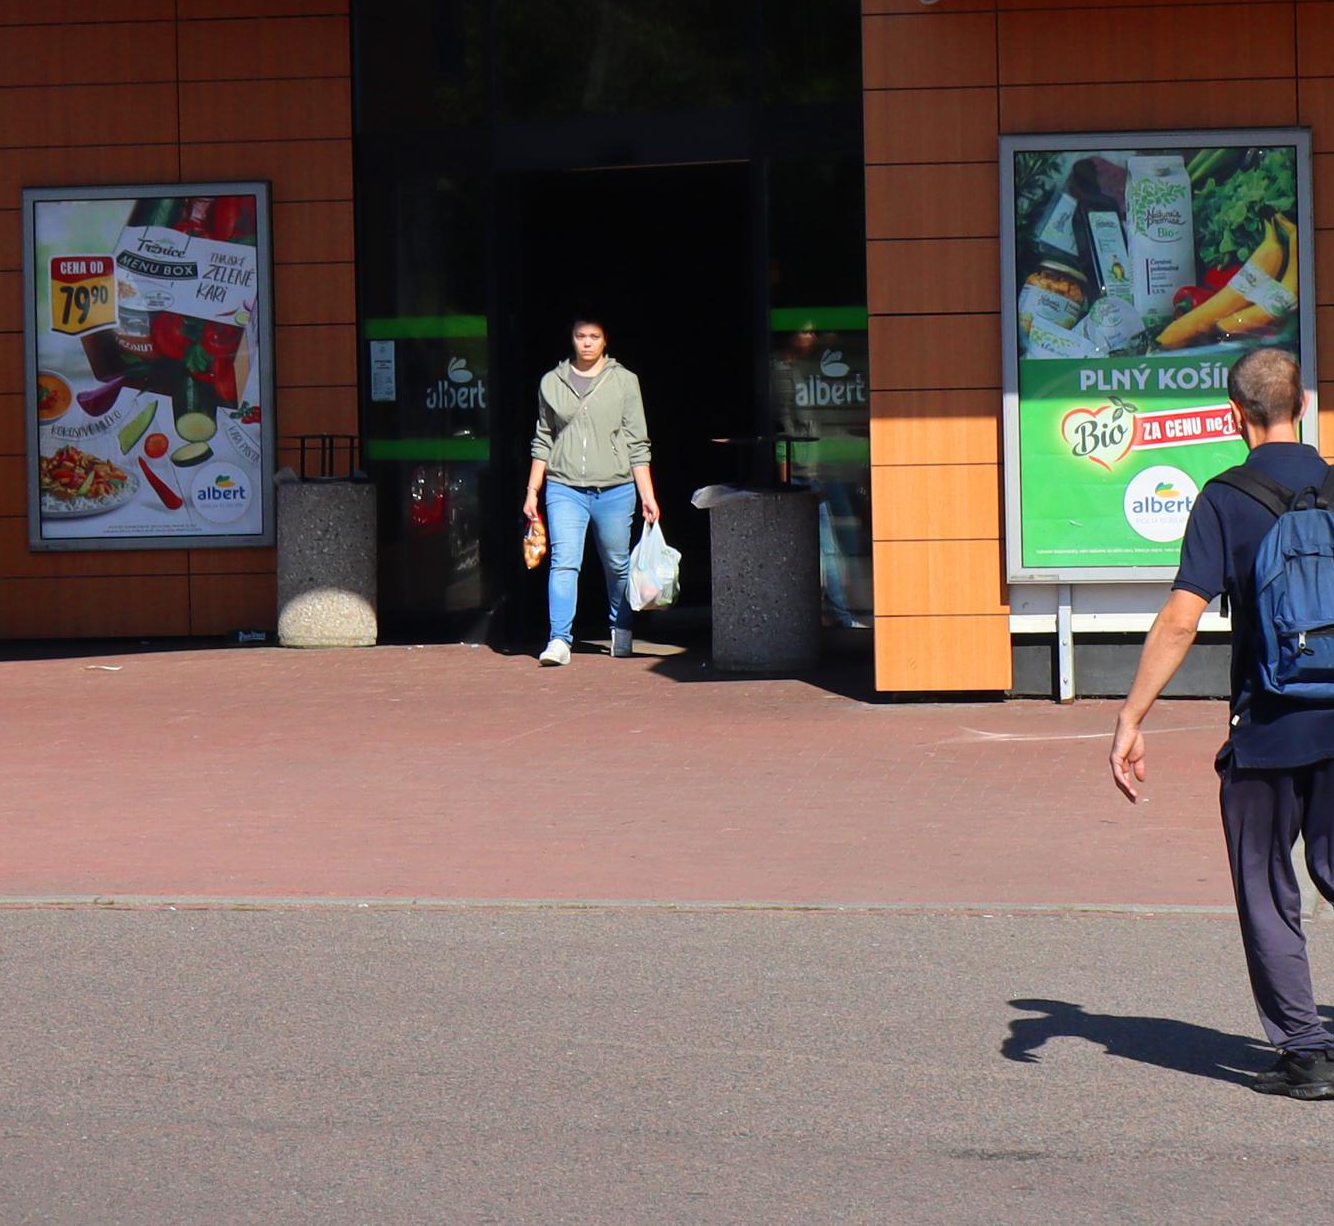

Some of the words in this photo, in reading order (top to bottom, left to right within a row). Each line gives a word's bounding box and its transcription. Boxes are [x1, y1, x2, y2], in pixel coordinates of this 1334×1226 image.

[60, 261, 87, 274] CENA
[90, 261, 104, 274] OD
[120, 255, 159, 274] MENU
[163, 265, 194, 276] BOX
[1079, 364, 1151, 390] PLNÝ
[427, 380, 486, 408] albert
[795, 374, 866, 406] albert
[1072, 420, 1128, 456] Bio
[1142, 422, 1162, 441] ZA
[1166, 417, 1202, 439] CENU
[197, 486, 246, 500] albert
[1133, 497, 1193, 513] albert
